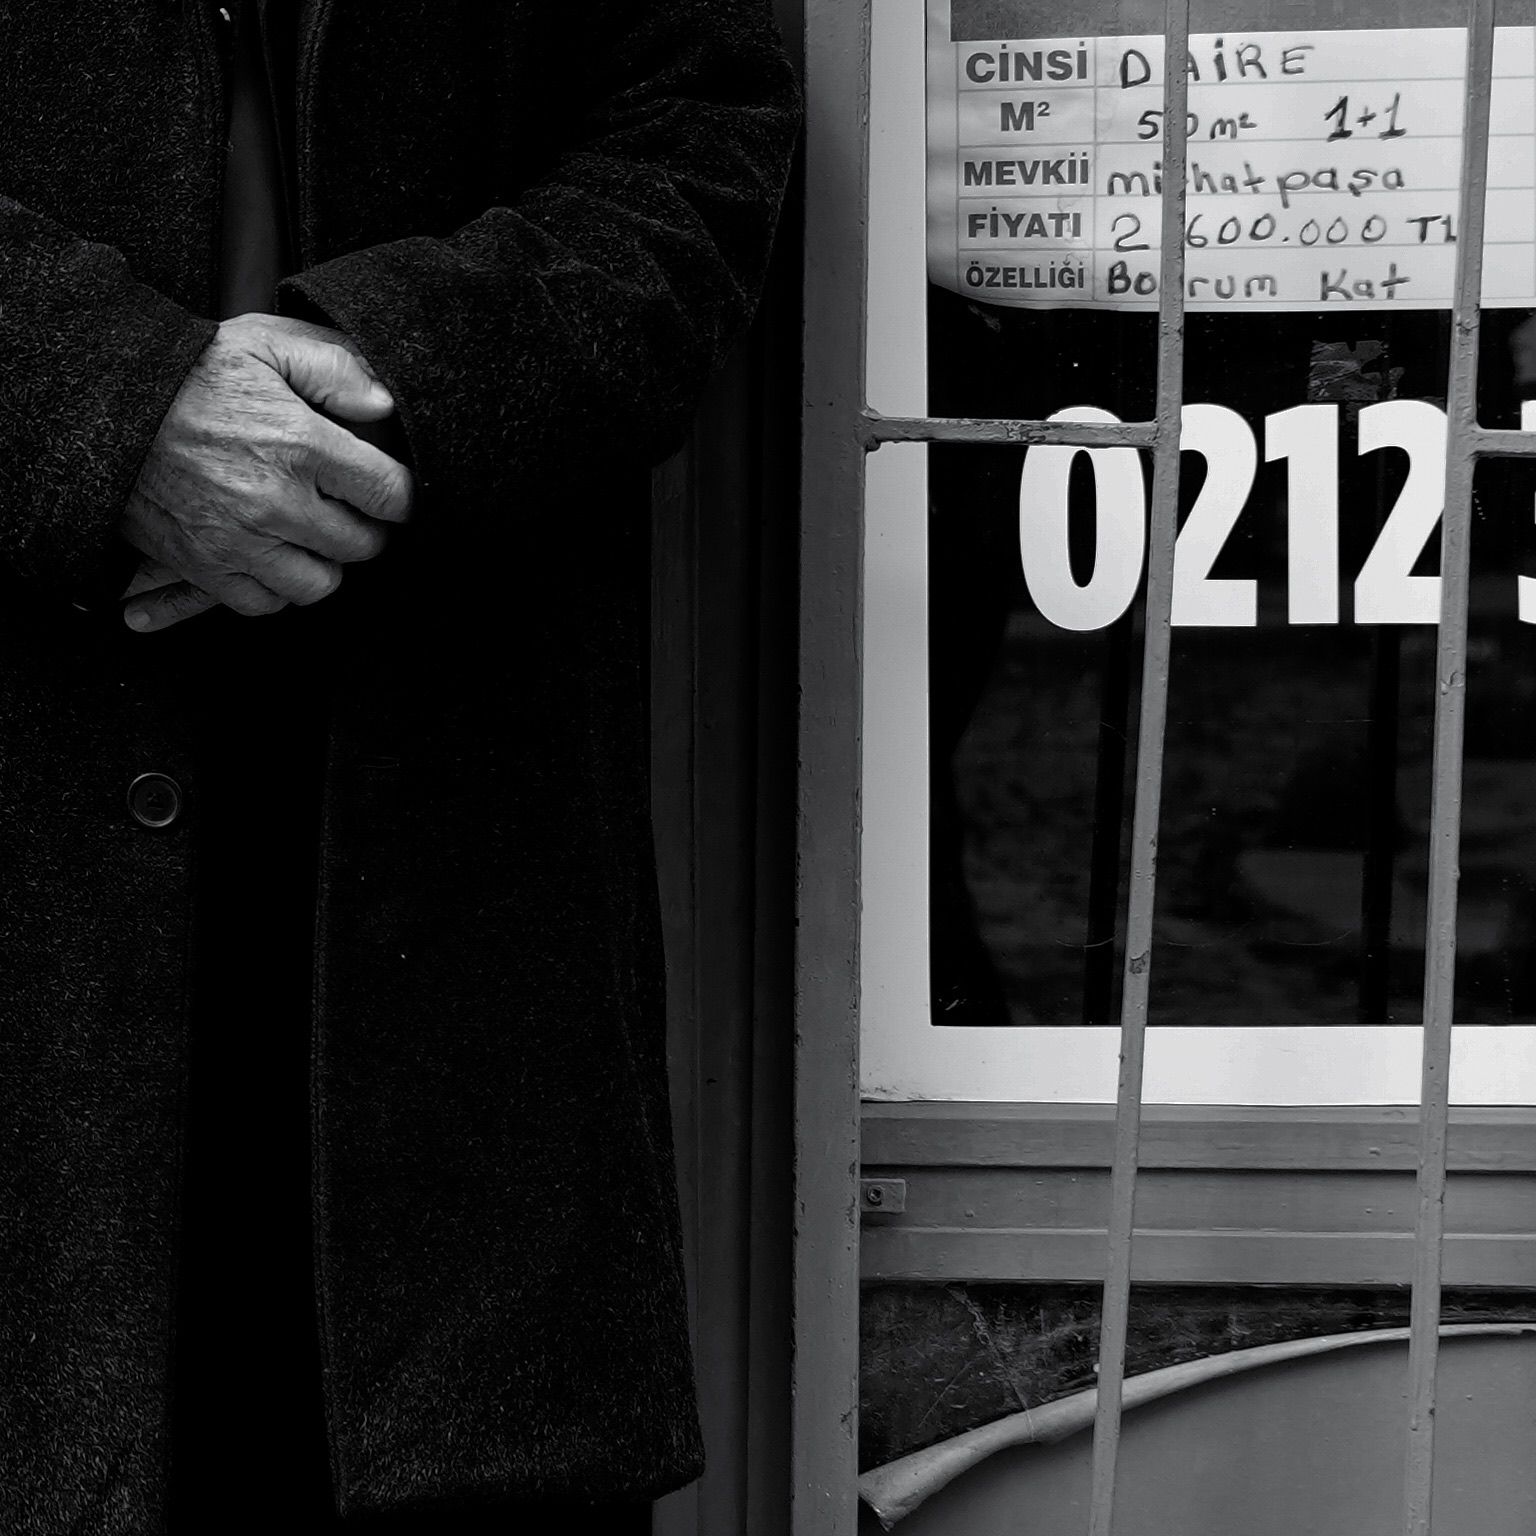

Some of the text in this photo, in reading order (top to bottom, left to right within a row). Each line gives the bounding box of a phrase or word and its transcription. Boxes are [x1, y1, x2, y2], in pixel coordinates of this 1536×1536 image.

[966, 41, 1087, 83] CİNSİ
[1324, 92, 1407, 143] 1+1
[964, 152, 1406, 209] MEVKİİ mihatpaşa
[968, 206, 1081, 238] FİYATI
[1111, 213, 1388, 252] 2600.000
[966, 261, 1085, 289] ÖZELLİĞİ
[1108, 260, 1278, 301] Borum
[1019, 400, 1448, 632] 0212
